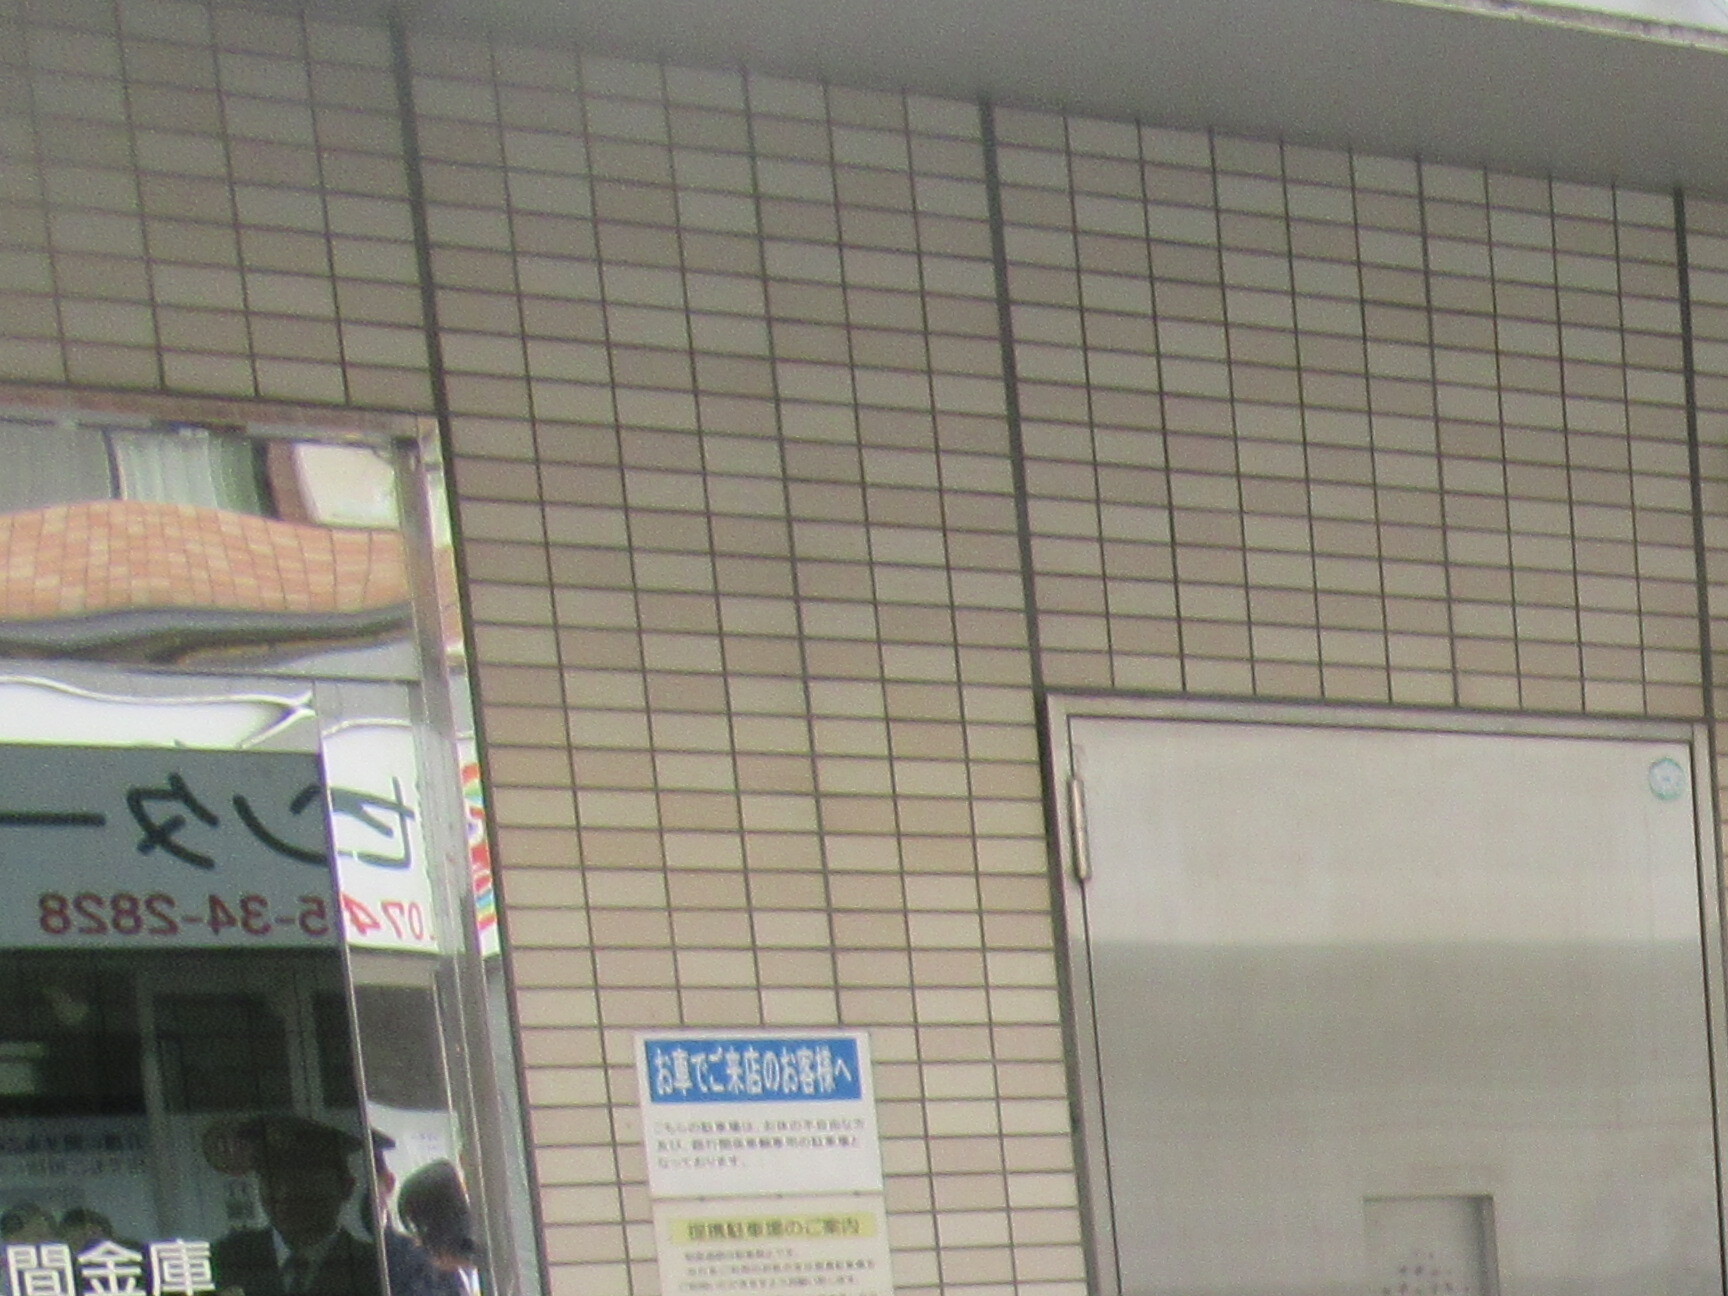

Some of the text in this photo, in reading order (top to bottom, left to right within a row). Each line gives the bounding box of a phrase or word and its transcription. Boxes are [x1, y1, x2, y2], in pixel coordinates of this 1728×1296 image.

[655, 1045, 851, 1096] お車でご来店のお客様へ
